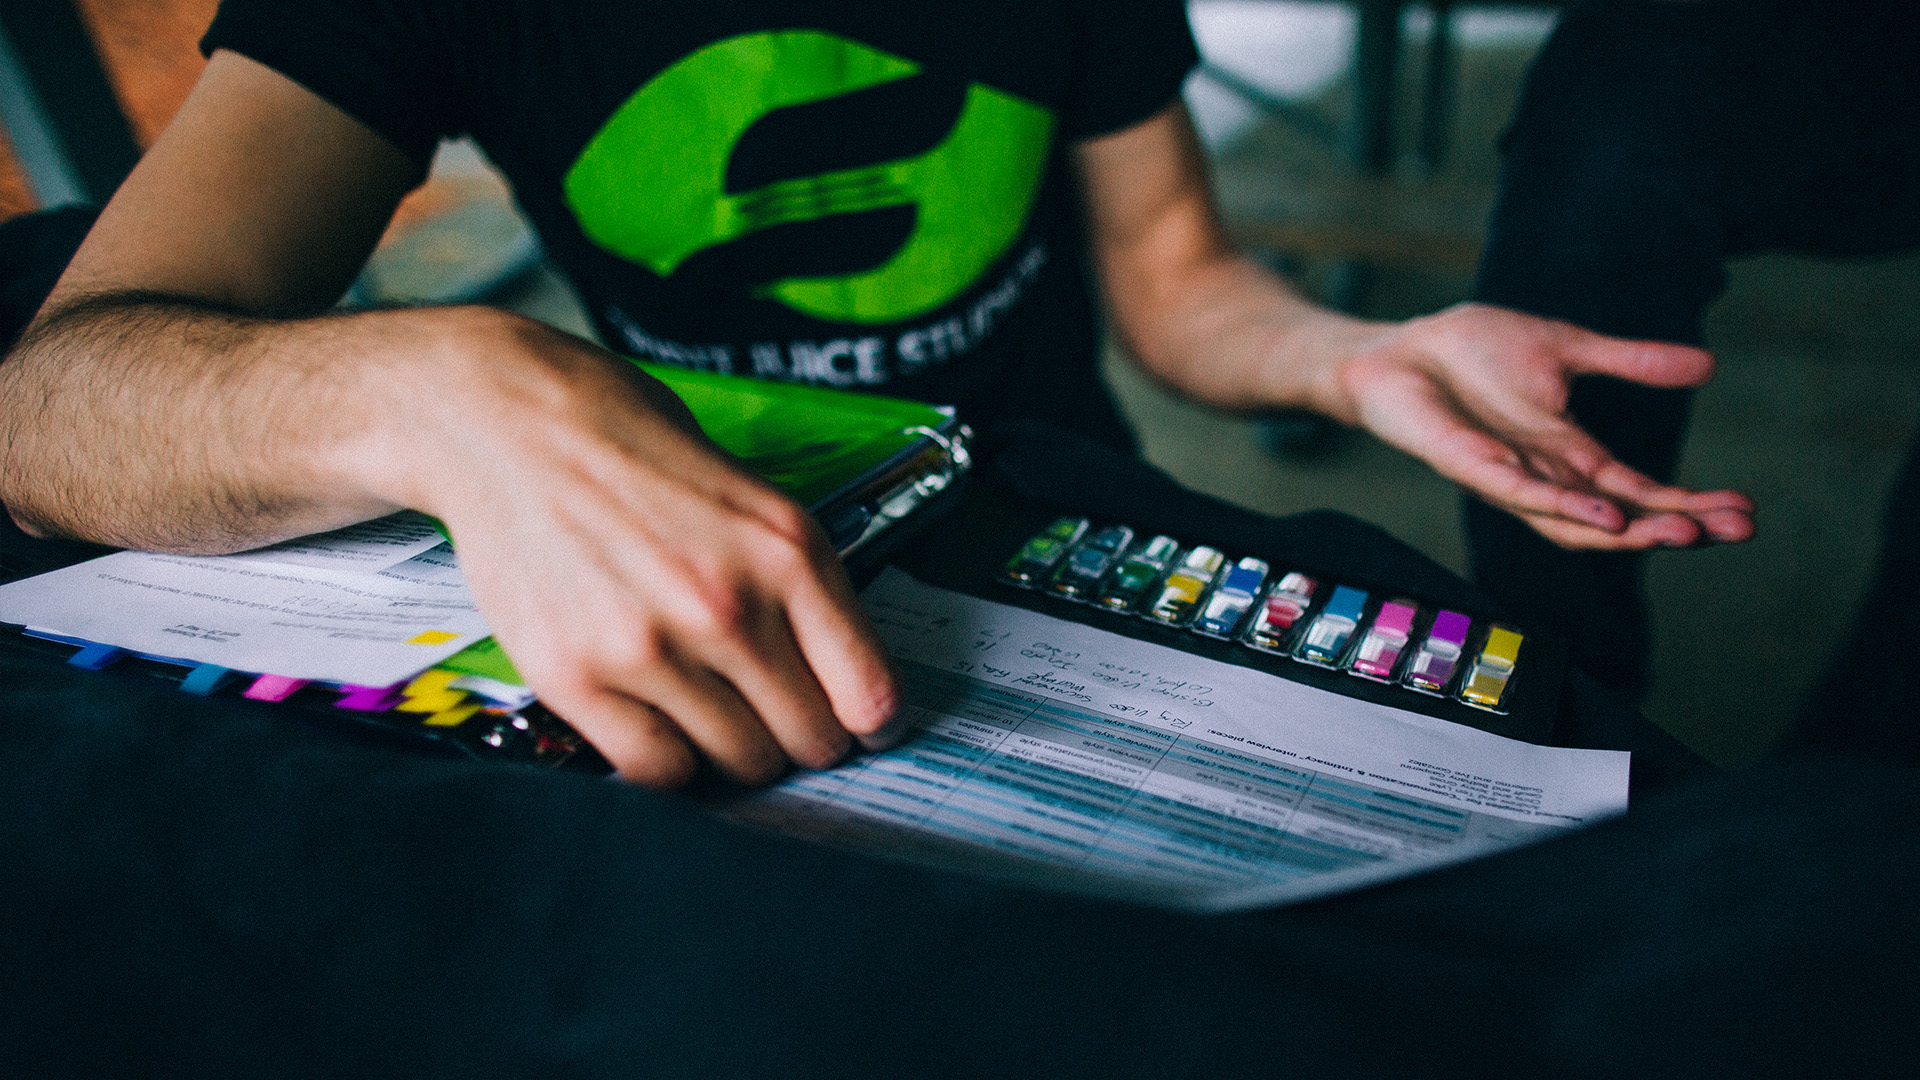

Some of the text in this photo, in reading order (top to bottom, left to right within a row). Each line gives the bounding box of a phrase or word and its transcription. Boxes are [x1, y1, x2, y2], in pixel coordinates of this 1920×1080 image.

[751, 335, 887, 385] JUICE
[1092, 672, 1141, 688] Video
[988, 688, 1024, 700] minutes
[977, 698, 1012, 711] minutes
[1108, 703, 1148, 717] Video
[964, 708, 1000, 721] minutes
[958, 720, 994, 733] minutes
[1104, 718, 1172, 740] Interview style
[948, 730, 985, 743] minutes
[1092, 730, 1162, 752] Interview style
[1206, 728, 1244, 742] pieces:
[1020, 738, 1042, 748] style
[1196, 743, 1224, 757] (TBD)
[1247, 740, 1297, 757] interview
[1011, 748, 1034, 759] style
[1082, 740, 1152, 763] Interview style
[1187, 756, 1216, 767] (TBD)
[1227, 752, 1258, 767] couple
[1298, 756, 1354, 772] Intimacy"
[1260, 762, 1298, 776] married
[1400, 763, 1446, 778] Gasperini
[1449, 774, 1489, 789] Bethany
[1473, 775, 1492, 783] and
[1369, 773, 1461, 800] "Communication
[1492, 786, 1511, 794] and
[1494, 780, 1543, 793] Guillermo
[1493, 791, 1512, 799] and
[1486, 802, 1531, 814] Couples
